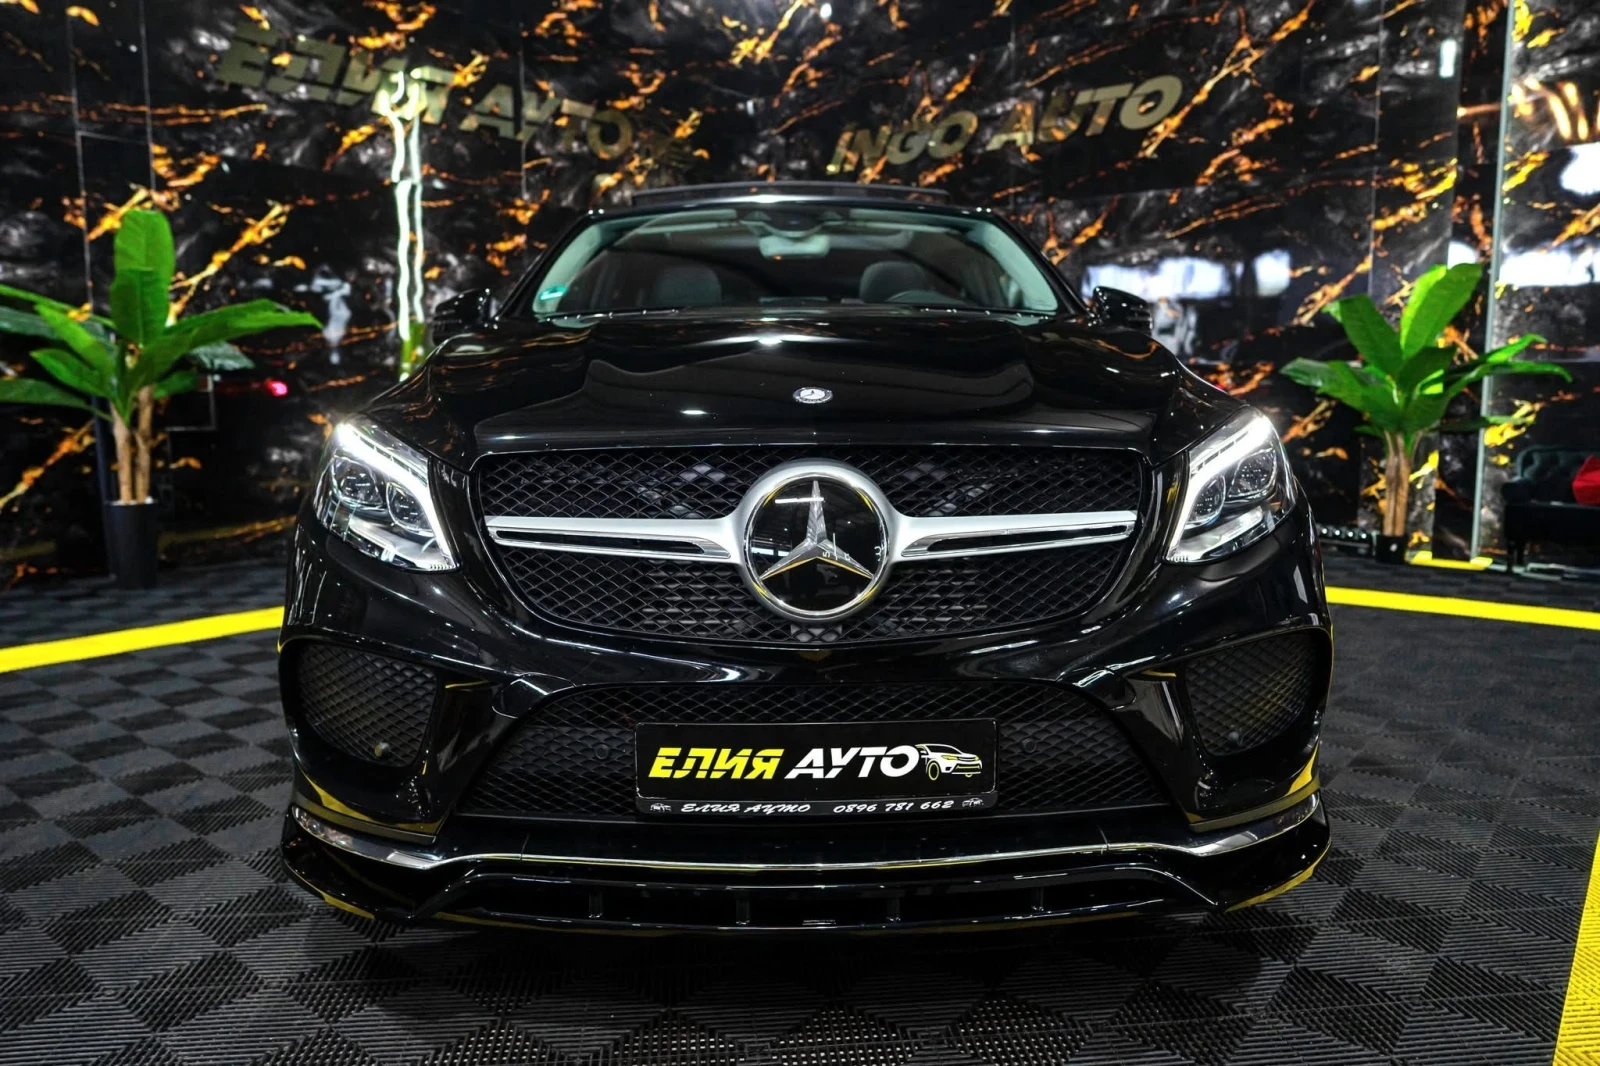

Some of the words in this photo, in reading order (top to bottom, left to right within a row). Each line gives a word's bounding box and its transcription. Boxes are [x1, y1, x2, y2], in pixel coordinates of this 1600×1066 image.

[826, 110, 978, 177] INGO
[986, 75, 1183, 151] AUTO
[648, 747, 785, 780] ЕЛИЯ
[784, 745, 920, 780] АУТО
[833, 803, 878, 813] 0896
[885, 802, 915, 812] 781
[920, 800, 954, 810] 662
